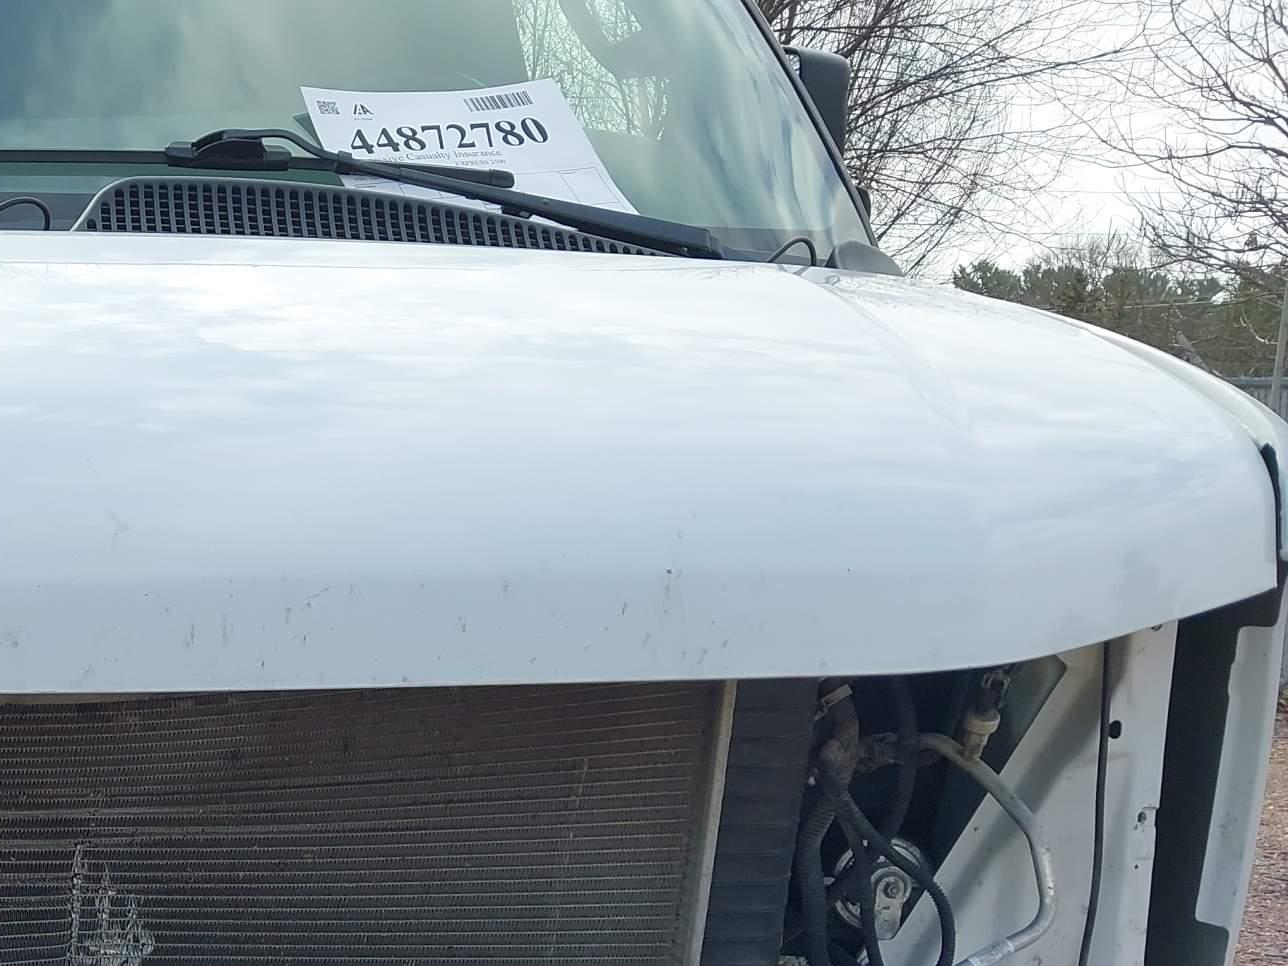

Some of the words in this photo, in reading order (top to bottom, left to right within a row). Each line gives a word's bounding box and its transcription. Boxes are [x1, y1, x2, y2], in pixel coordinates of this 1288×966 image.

[350, 117, 549, 155] 44872780
[405, 150, 451, 161] Casualty
[453, 150, 503, 158] Insurance
